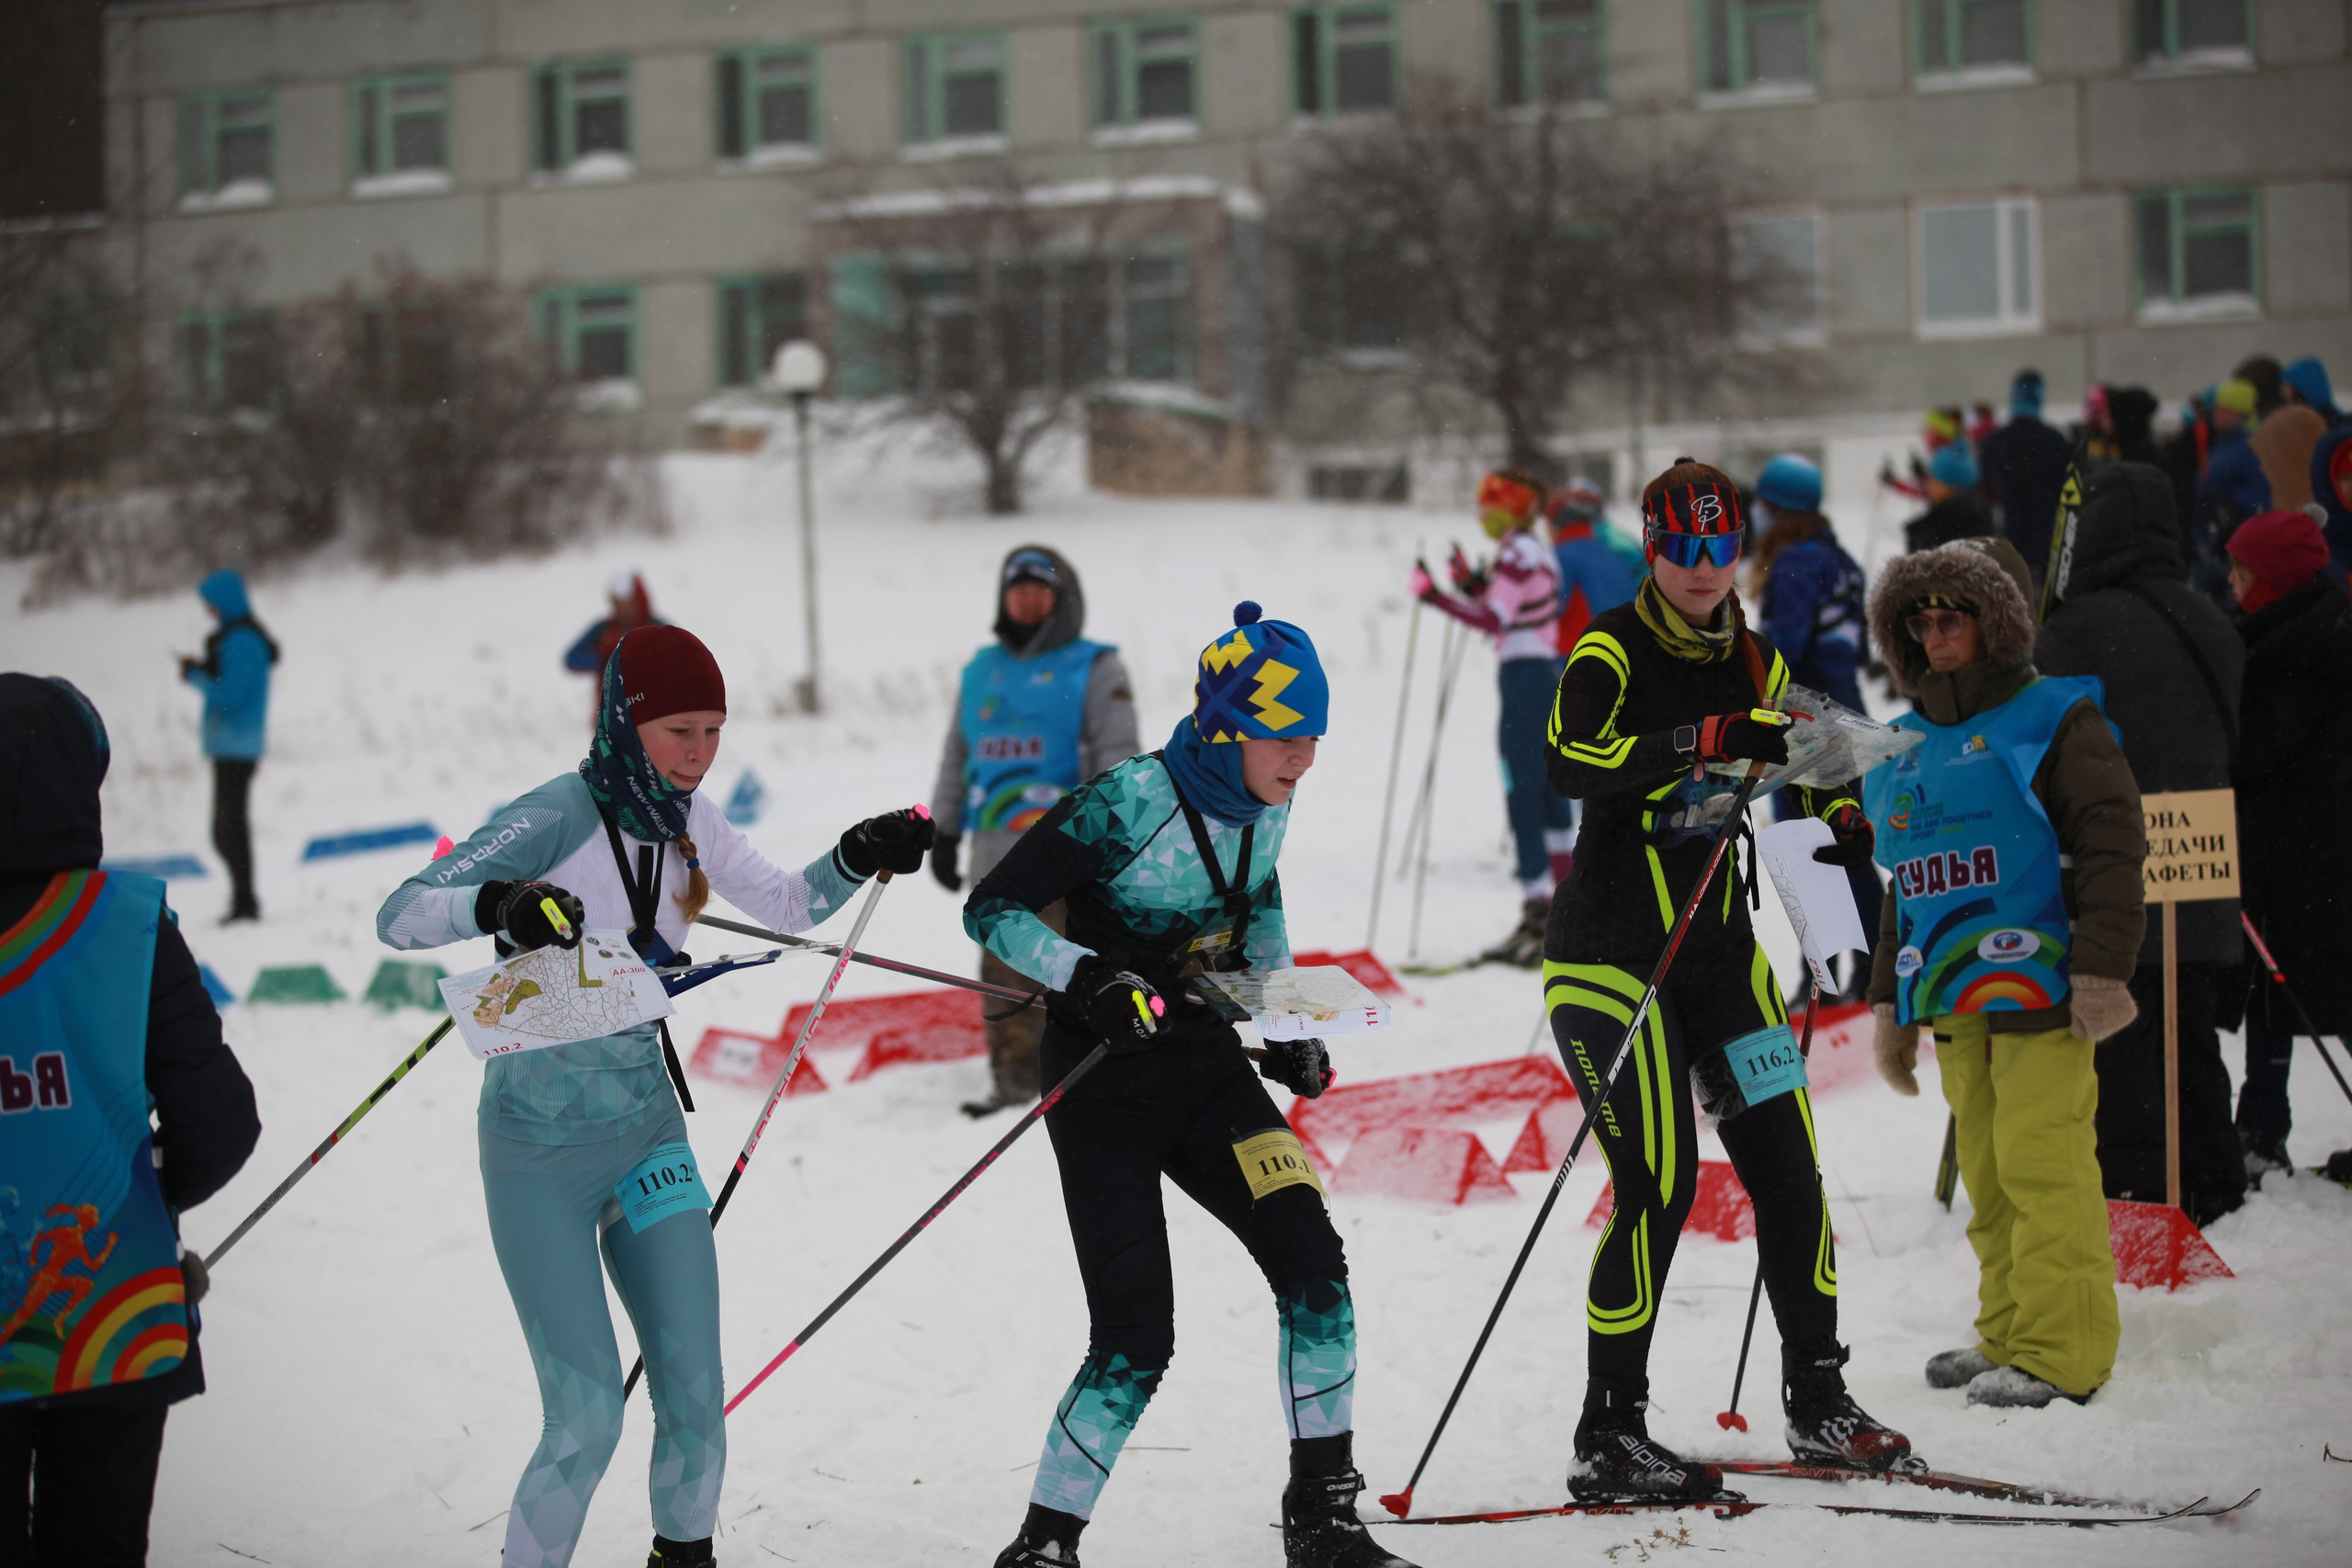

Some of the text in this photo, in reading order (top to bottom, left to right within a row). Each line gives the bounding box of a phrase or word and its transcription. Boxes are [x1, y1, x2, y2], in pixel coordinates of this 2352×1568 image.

[646, 802, 676, 840] WALLET
[1941, 810, 1993, 825] TOGETHER
[2143, 810, 2191, 830] ОНА
[1910, 828, 1936, 842] SPORT
[2145, 834, 2225, 859] ЕДАЧИ
[436, 817, 531, 884] NORDSKI
[1894, 845, 1999, 900] СУДЬЯ
[2143, 861, 2231, 884] АФЕТЫ
[1809, 957, 1826, 985] 116.2
[483, 1042, 523, 1055] 110.2
[1746, 1045, 1795, 1077] 116.2
[0, 1053, 73, 1114] ЬЯ
[1257, 1154, 1311, 1177] 110.1
[637, 1163, 693, 1197] 110.2
[1814, 1358, 1838, 1367] alpina
[1618, 1435, 1688, 1487] alpina
